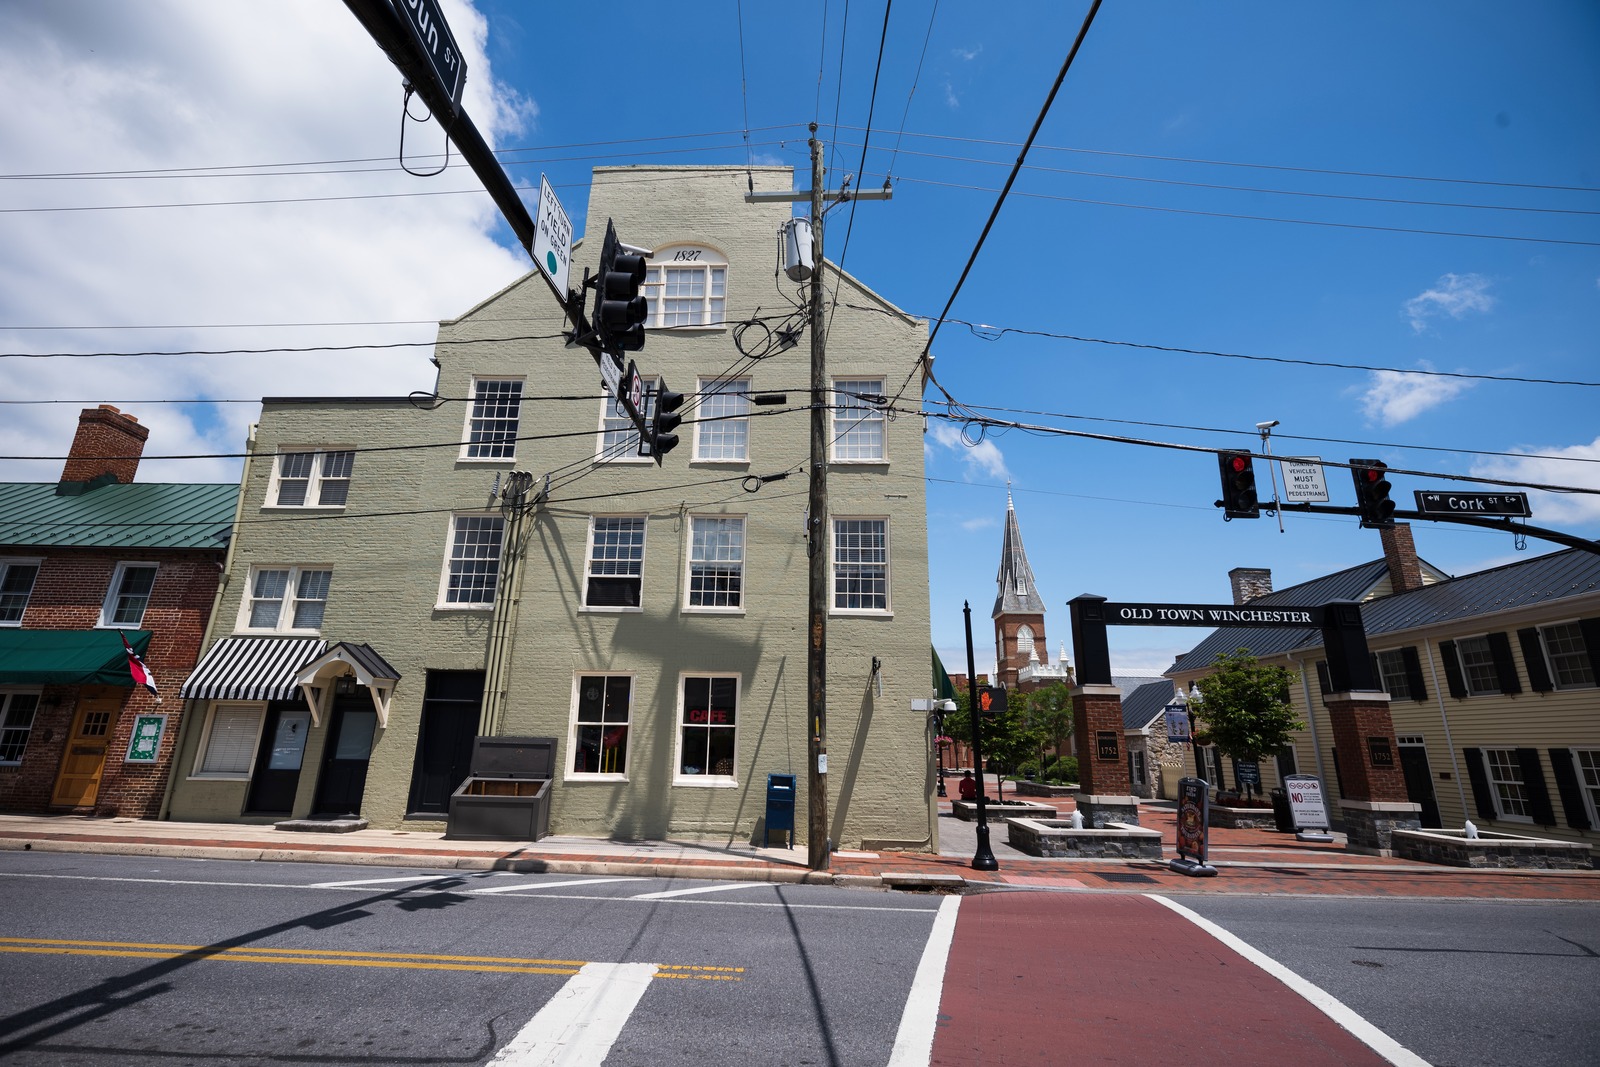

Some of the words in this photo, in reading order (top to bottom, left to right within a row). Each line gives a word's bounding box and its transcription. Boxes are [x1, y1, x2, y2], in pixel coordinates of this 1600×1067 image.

[444, 46, 456, 71] ST
[543, 185, 558, 213] LEFT
[557, 207, 570, 237] TURN
[546, 206, 566, 248] YIELD
[540, 219, 549, 238] ON
[550, 235, 567, 267] GREEN
[673, 250, 702, 262] 1827
[1433, 494, 1440, 502] W
[1448, 497, 1485, 510] Cork
[1120, 608, 1153, 620] OLD
[1157, 608, 1205, 621] TOWN
[1208, 610, 1313, 623] WINCHESTER
[690, 709, 727, 723] CAFE
[1100, 746, 1117, 755] 1752
[1374, 752, 1391, 761] 1752
[1291, 792, 1304, 804] NO
